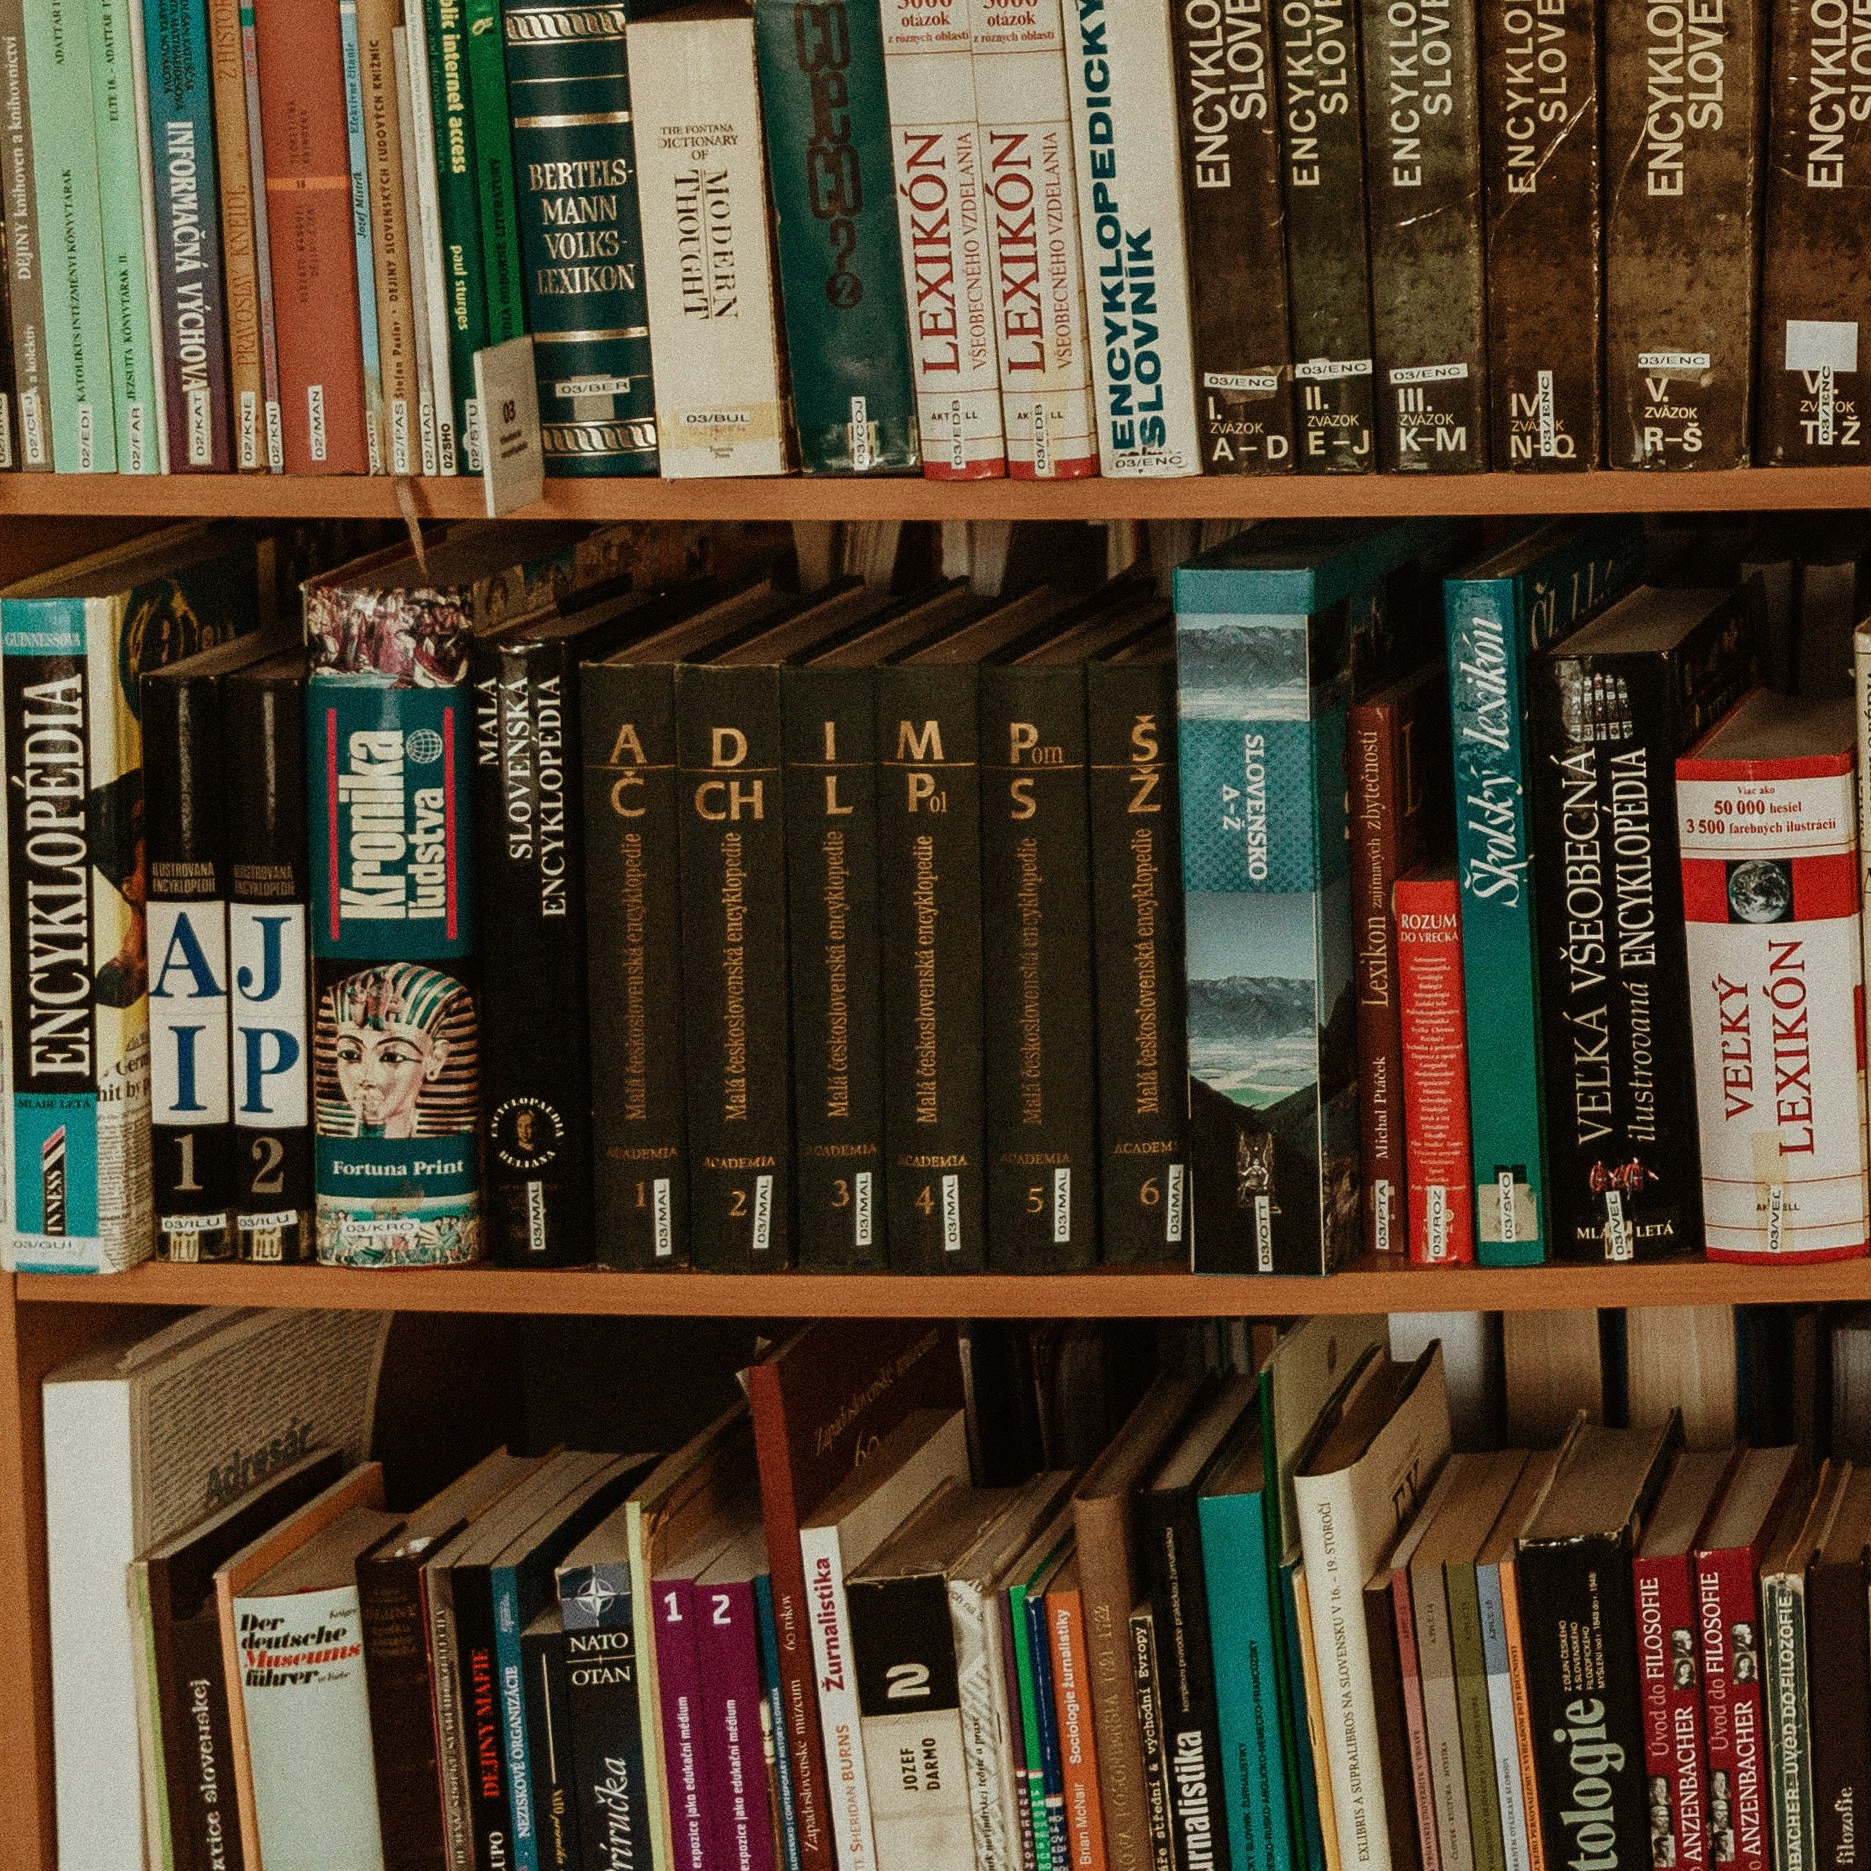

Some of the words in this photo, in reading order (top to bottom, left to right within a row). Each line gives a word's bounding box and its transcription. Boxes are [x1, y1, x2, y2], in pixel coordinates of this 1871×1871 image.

[531, 158, 635, 188] BERTELS-
[543, 196, 616, 223] MANN
[675, 170, 707, 318] THOUGHT
[706, 171, 736, 317] MODERN
[1124, 228, 1166, 447] SLOVNÍK
[1460, 616, 1512, 750] lexikón
[339, 727, 407, 919] Kronika
[502, 676, 533, 859] SLOVENSKÁ
[536, 677, 565, 915] ENCYKLOPÉDIA
[1243, 735, 1267, 880] SLOVENSKO
[1463, 767, 1523, 906] Školský
[1714, 799, 1733, 814] 50
[1736, 799, 1765, 814] 000
[1769, 799, 1802, 813] hesiel
[12, 673, 91, 1075] ENCYKLOPÉDIA
[406, 788, 446, 918] ľudstva
[1552, 746, 1605, 992] VŠEOBECNÁ
[1606, 748, 1653, 965] ENCYKLOPÉDIA
[1563, 1005, 1613, 1143] VEĽKÁ
[1713, 974, 1753, 1120] VEĽKÝ
[1764, 941, 1814, 1155] LEXIKÓN
[333, 1161, 407, 1175] Fortuna
[413, 1159, 464, 1174] Print
[571, 1632, 631, 1652] NATO
[572, 1666, 630, 1686] OTAN
[813, 1557, 844, 1691] Žurnalistika
[900, 1748, 917, 1790] JOZEF
[922, 1738, 940, 1790] DARMO
